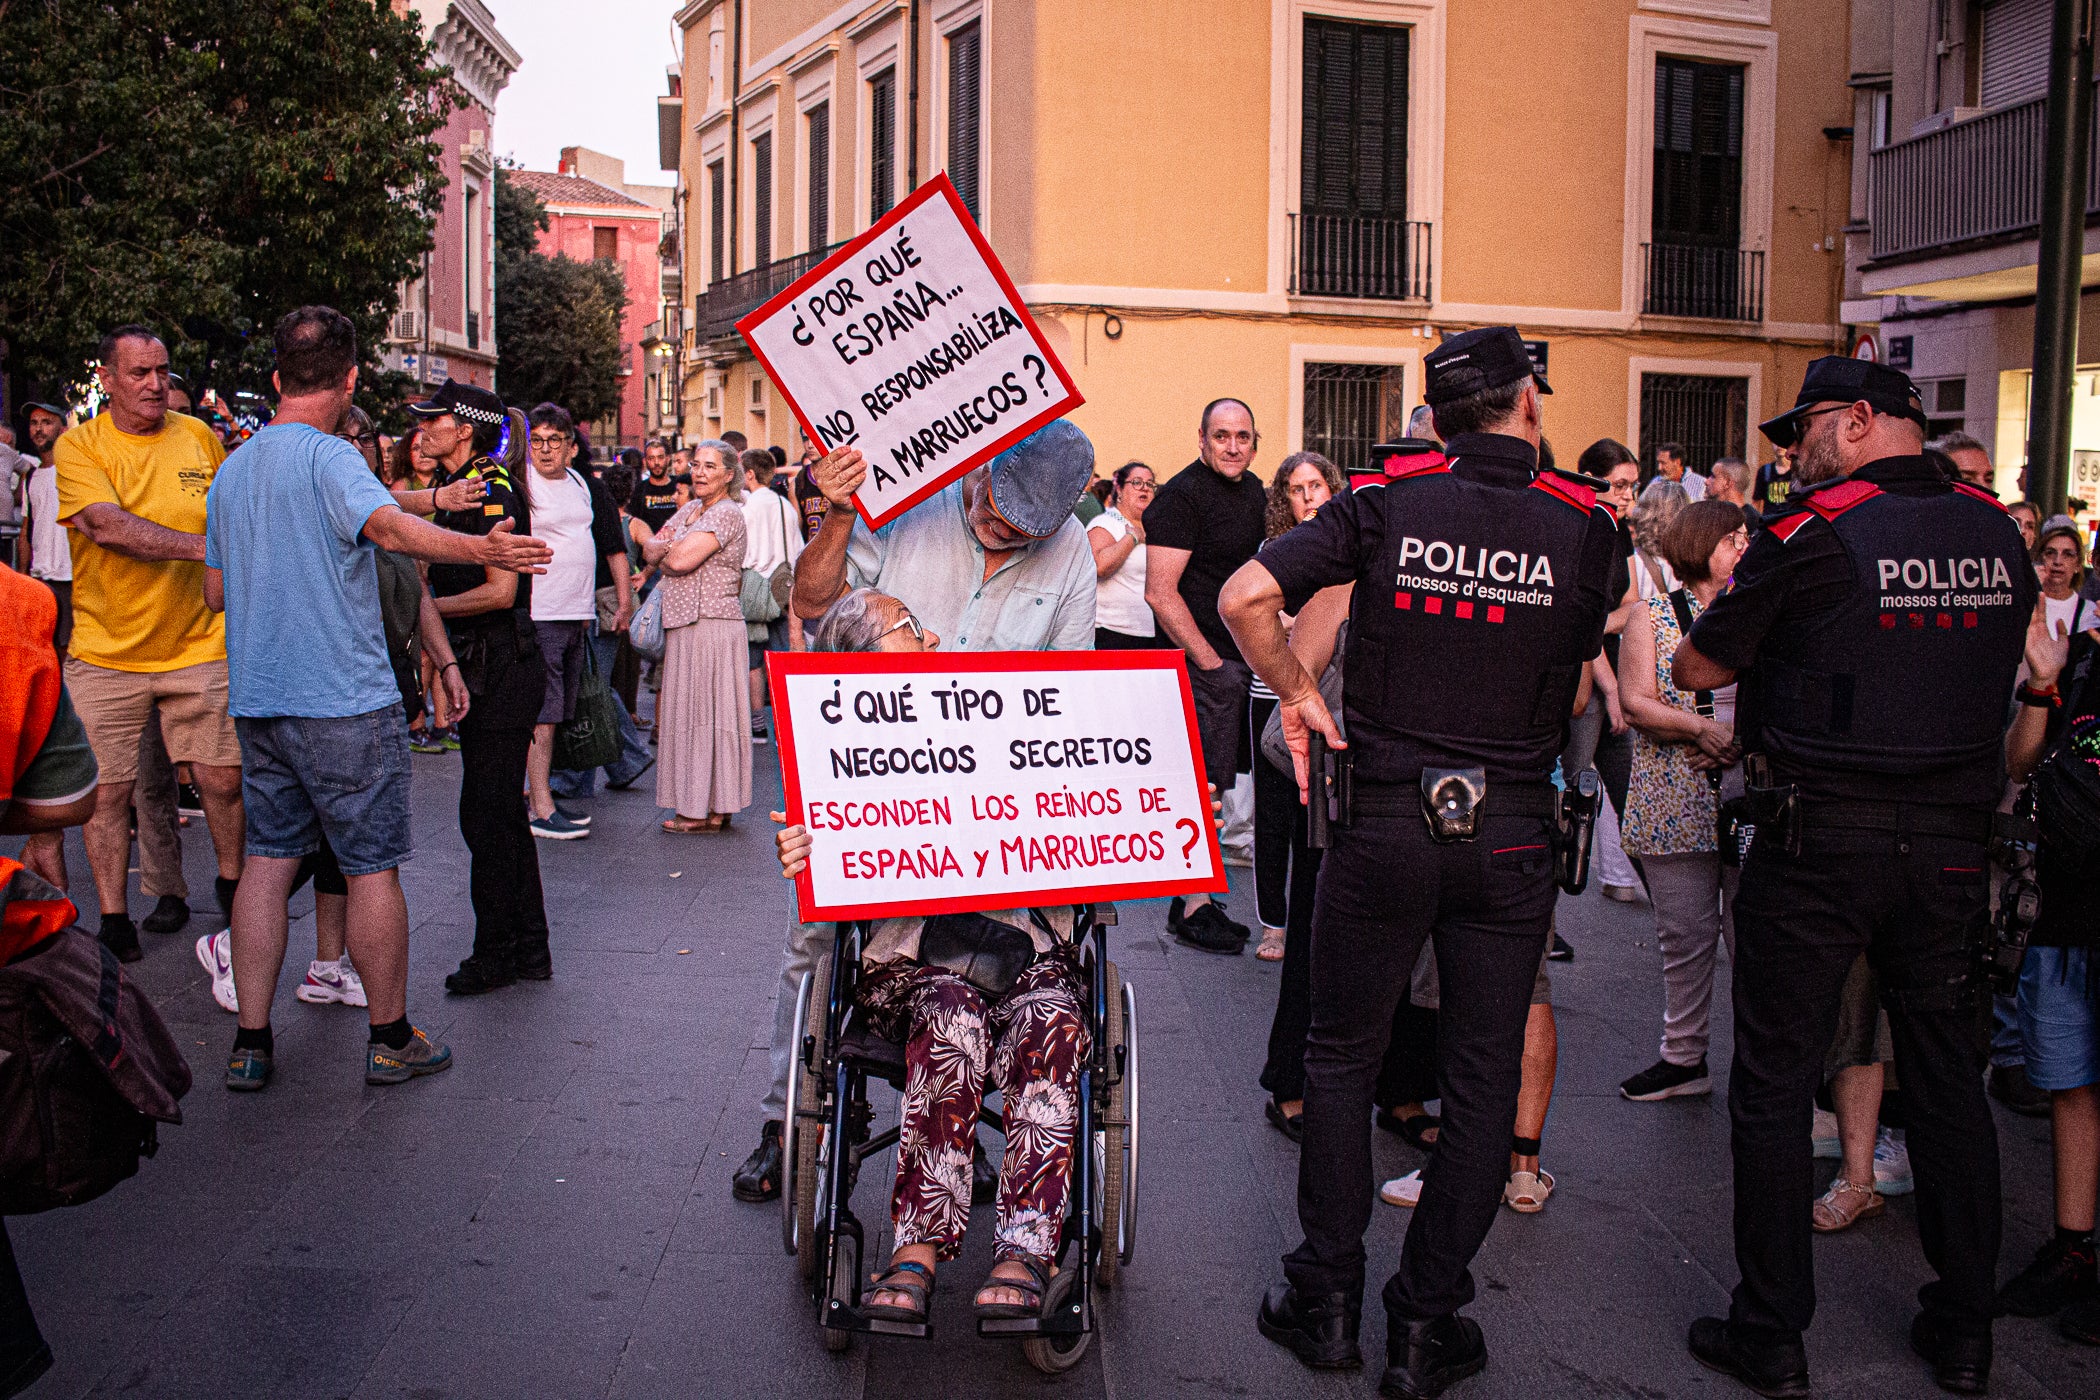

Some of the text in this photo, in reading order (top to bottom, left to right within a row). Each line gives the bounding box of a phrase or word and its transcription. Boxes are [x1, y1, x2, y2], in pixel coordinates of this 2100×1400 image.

[865, 225, 921, 286] QUÉ
[815, 306, 1023, 448] NO RESPONSABILIZA
[872, 464, 897, 491] A
[1398, 536, 1555, 587] POLICIA
[1877, 557, 2013, 590] POLICIA
[1396, 573, 1553, 606] mossos d'esquadra
[1880, 595, 1937, 608] mossos
[932, 680, 1004, 722] TIPO
[1023, 687, 1062, 718] DE
[830, 737, 1152, 779] NEGOCIOS SECRETOS
[808, 784, 1172, 832] ESCONDEN LOS REINOS DE
[841, 843, 964, 880] ESPAÑA
